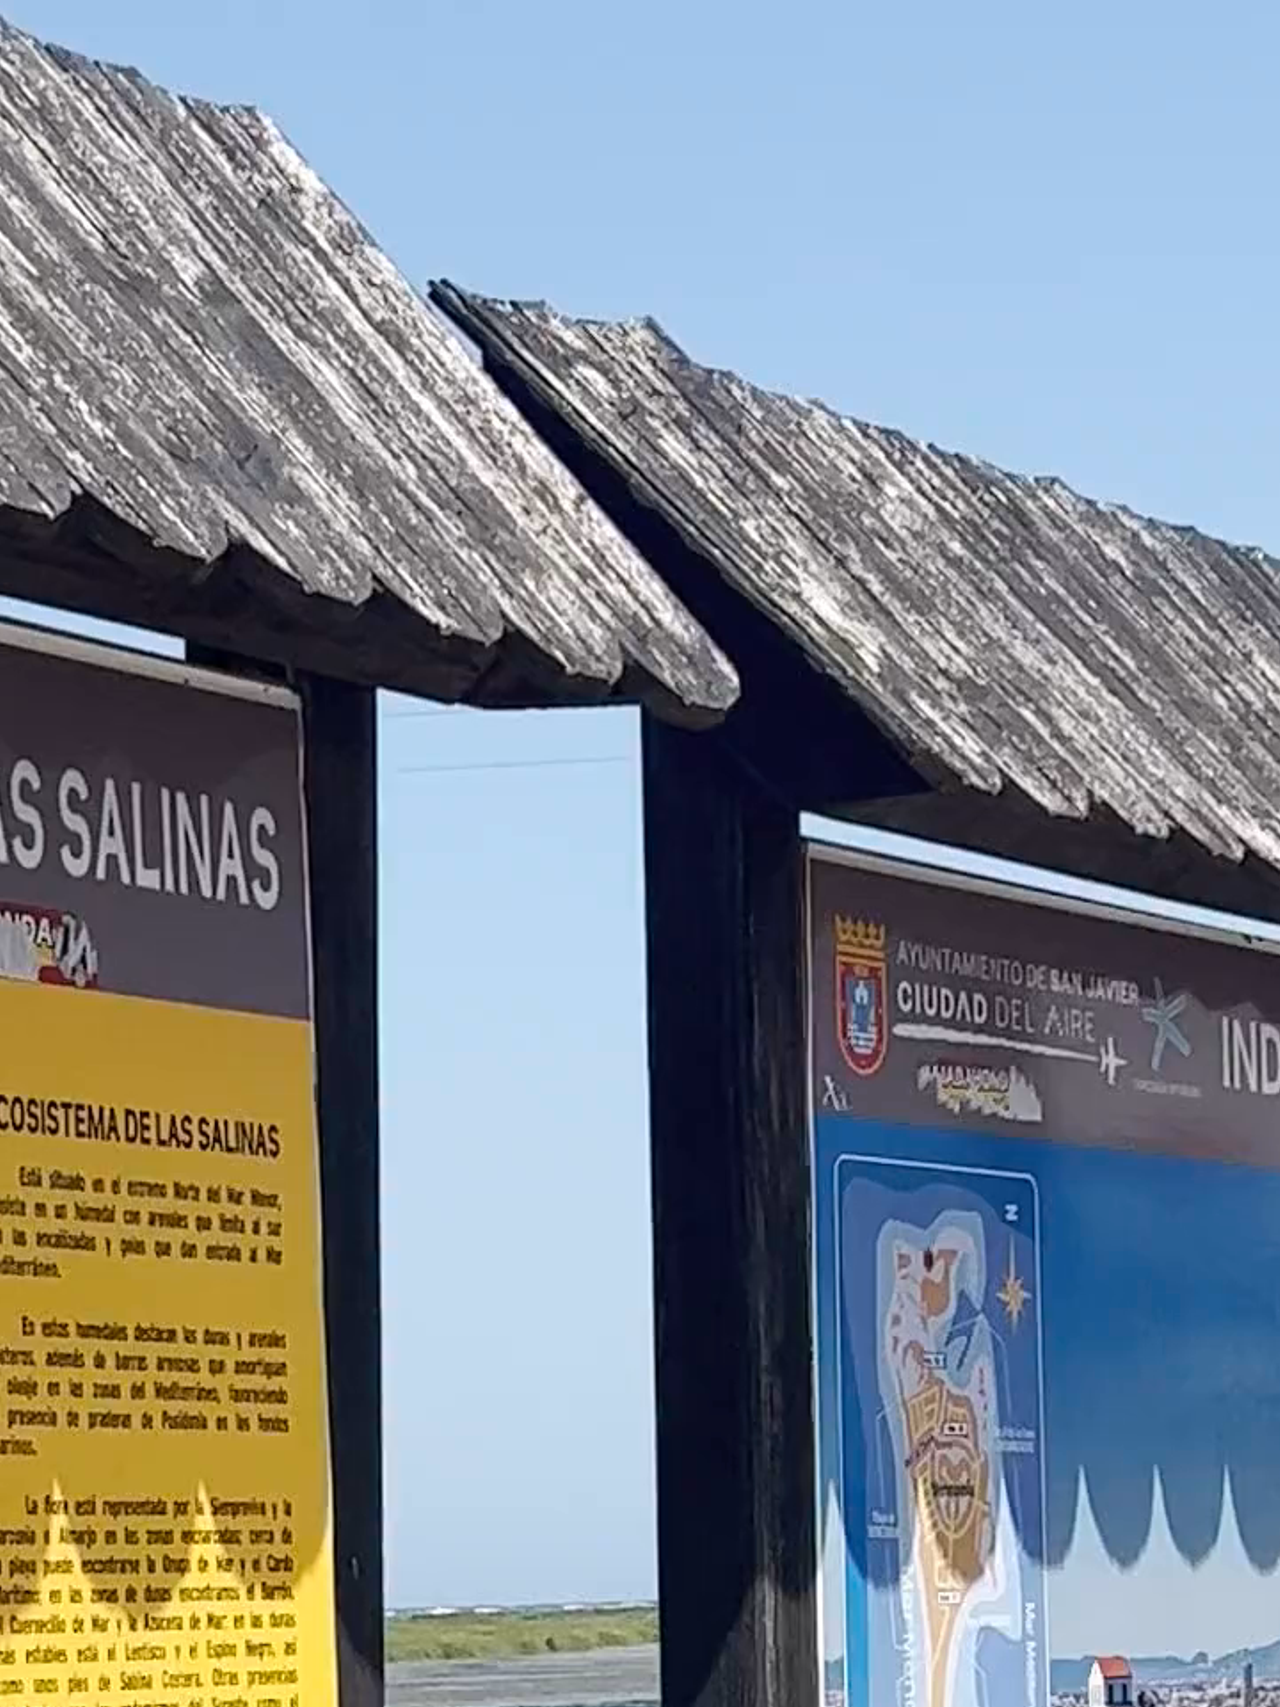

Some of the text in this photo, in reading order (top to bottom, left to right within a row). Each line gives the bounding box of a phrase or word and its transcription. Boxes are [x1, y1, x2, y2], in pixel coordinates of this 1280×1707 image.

[59, 770, 279, 909] SALINAS
[896, 941, 1138, 1005] AYUNTAMIENTO DE SAN JAVIER
[896, 980, 1095, 1042] CIUDAD DEL AIRE
[123, 1107, 153, 1147] DE
[154, 1111, 195, 1150] LAS
[197, 1115, 281, 1160] SALINAS
